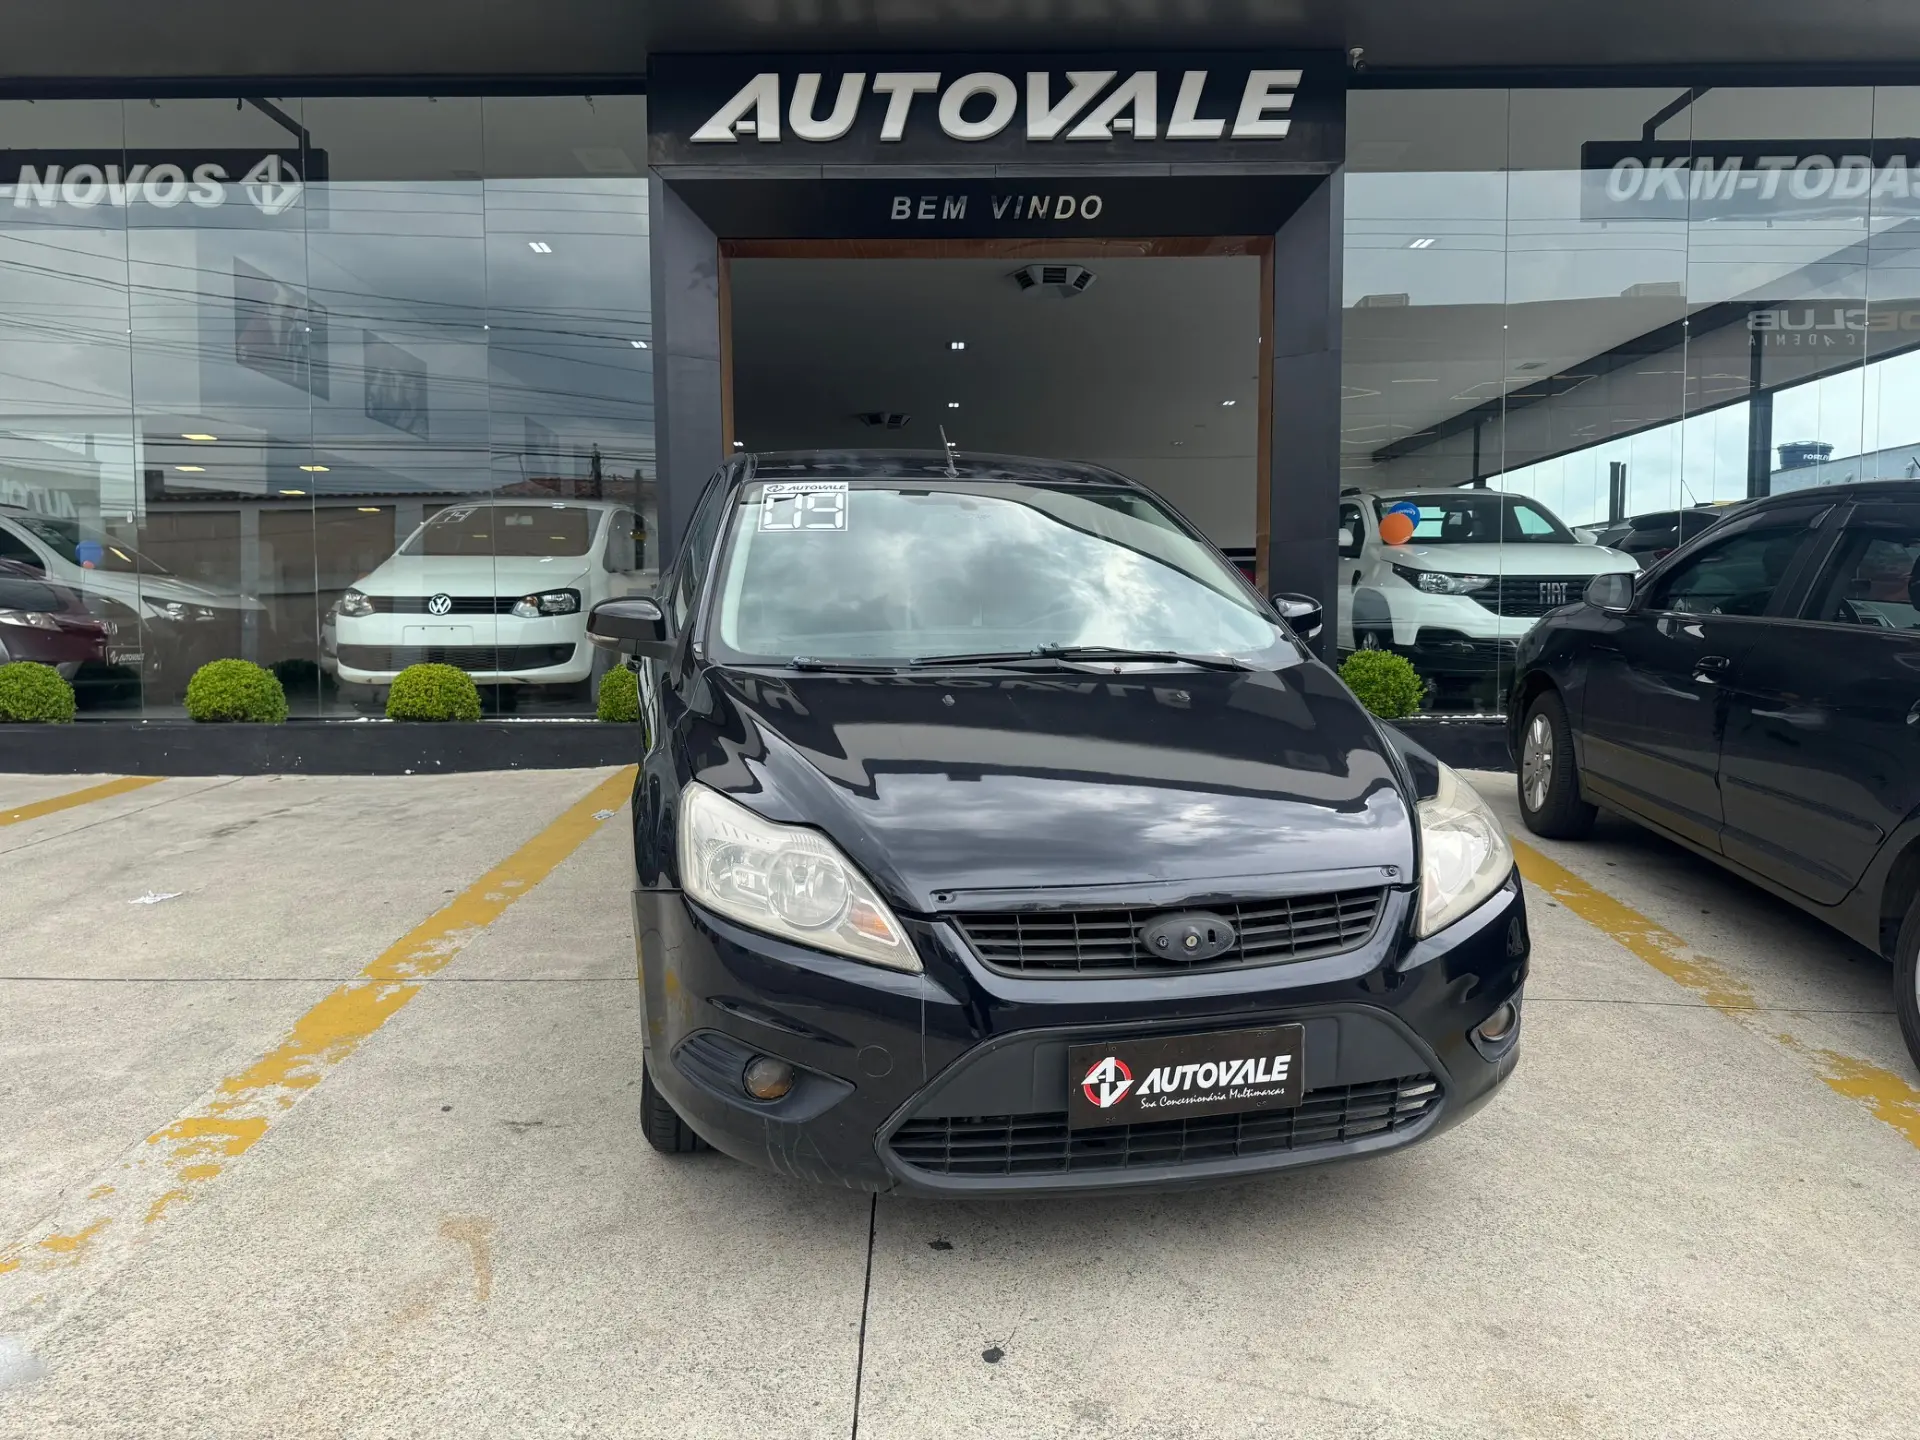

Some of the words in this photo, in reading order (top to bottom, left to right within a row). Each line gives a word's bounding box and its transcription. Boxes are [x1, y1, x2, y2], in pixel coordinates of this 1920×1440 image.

[688, 69, 1304, 142] AUTOVALE
[890, 195, 968, 220] BEM
[991, 195, 1103, 220] VINDO
[787, 483, 847, 492] AUTOVALE
[763, 492, 844, 529] 09
[1539, 582, 1568, 605] FIAT
[1135, 1054, 1292, 1095] AUTOVALE
[1140, 1096, 1158, 1110] Sua
[1160, 1091, 1227, 1108] Concessionária
[1229, 1086, 1286, 1100] Multimarcas
